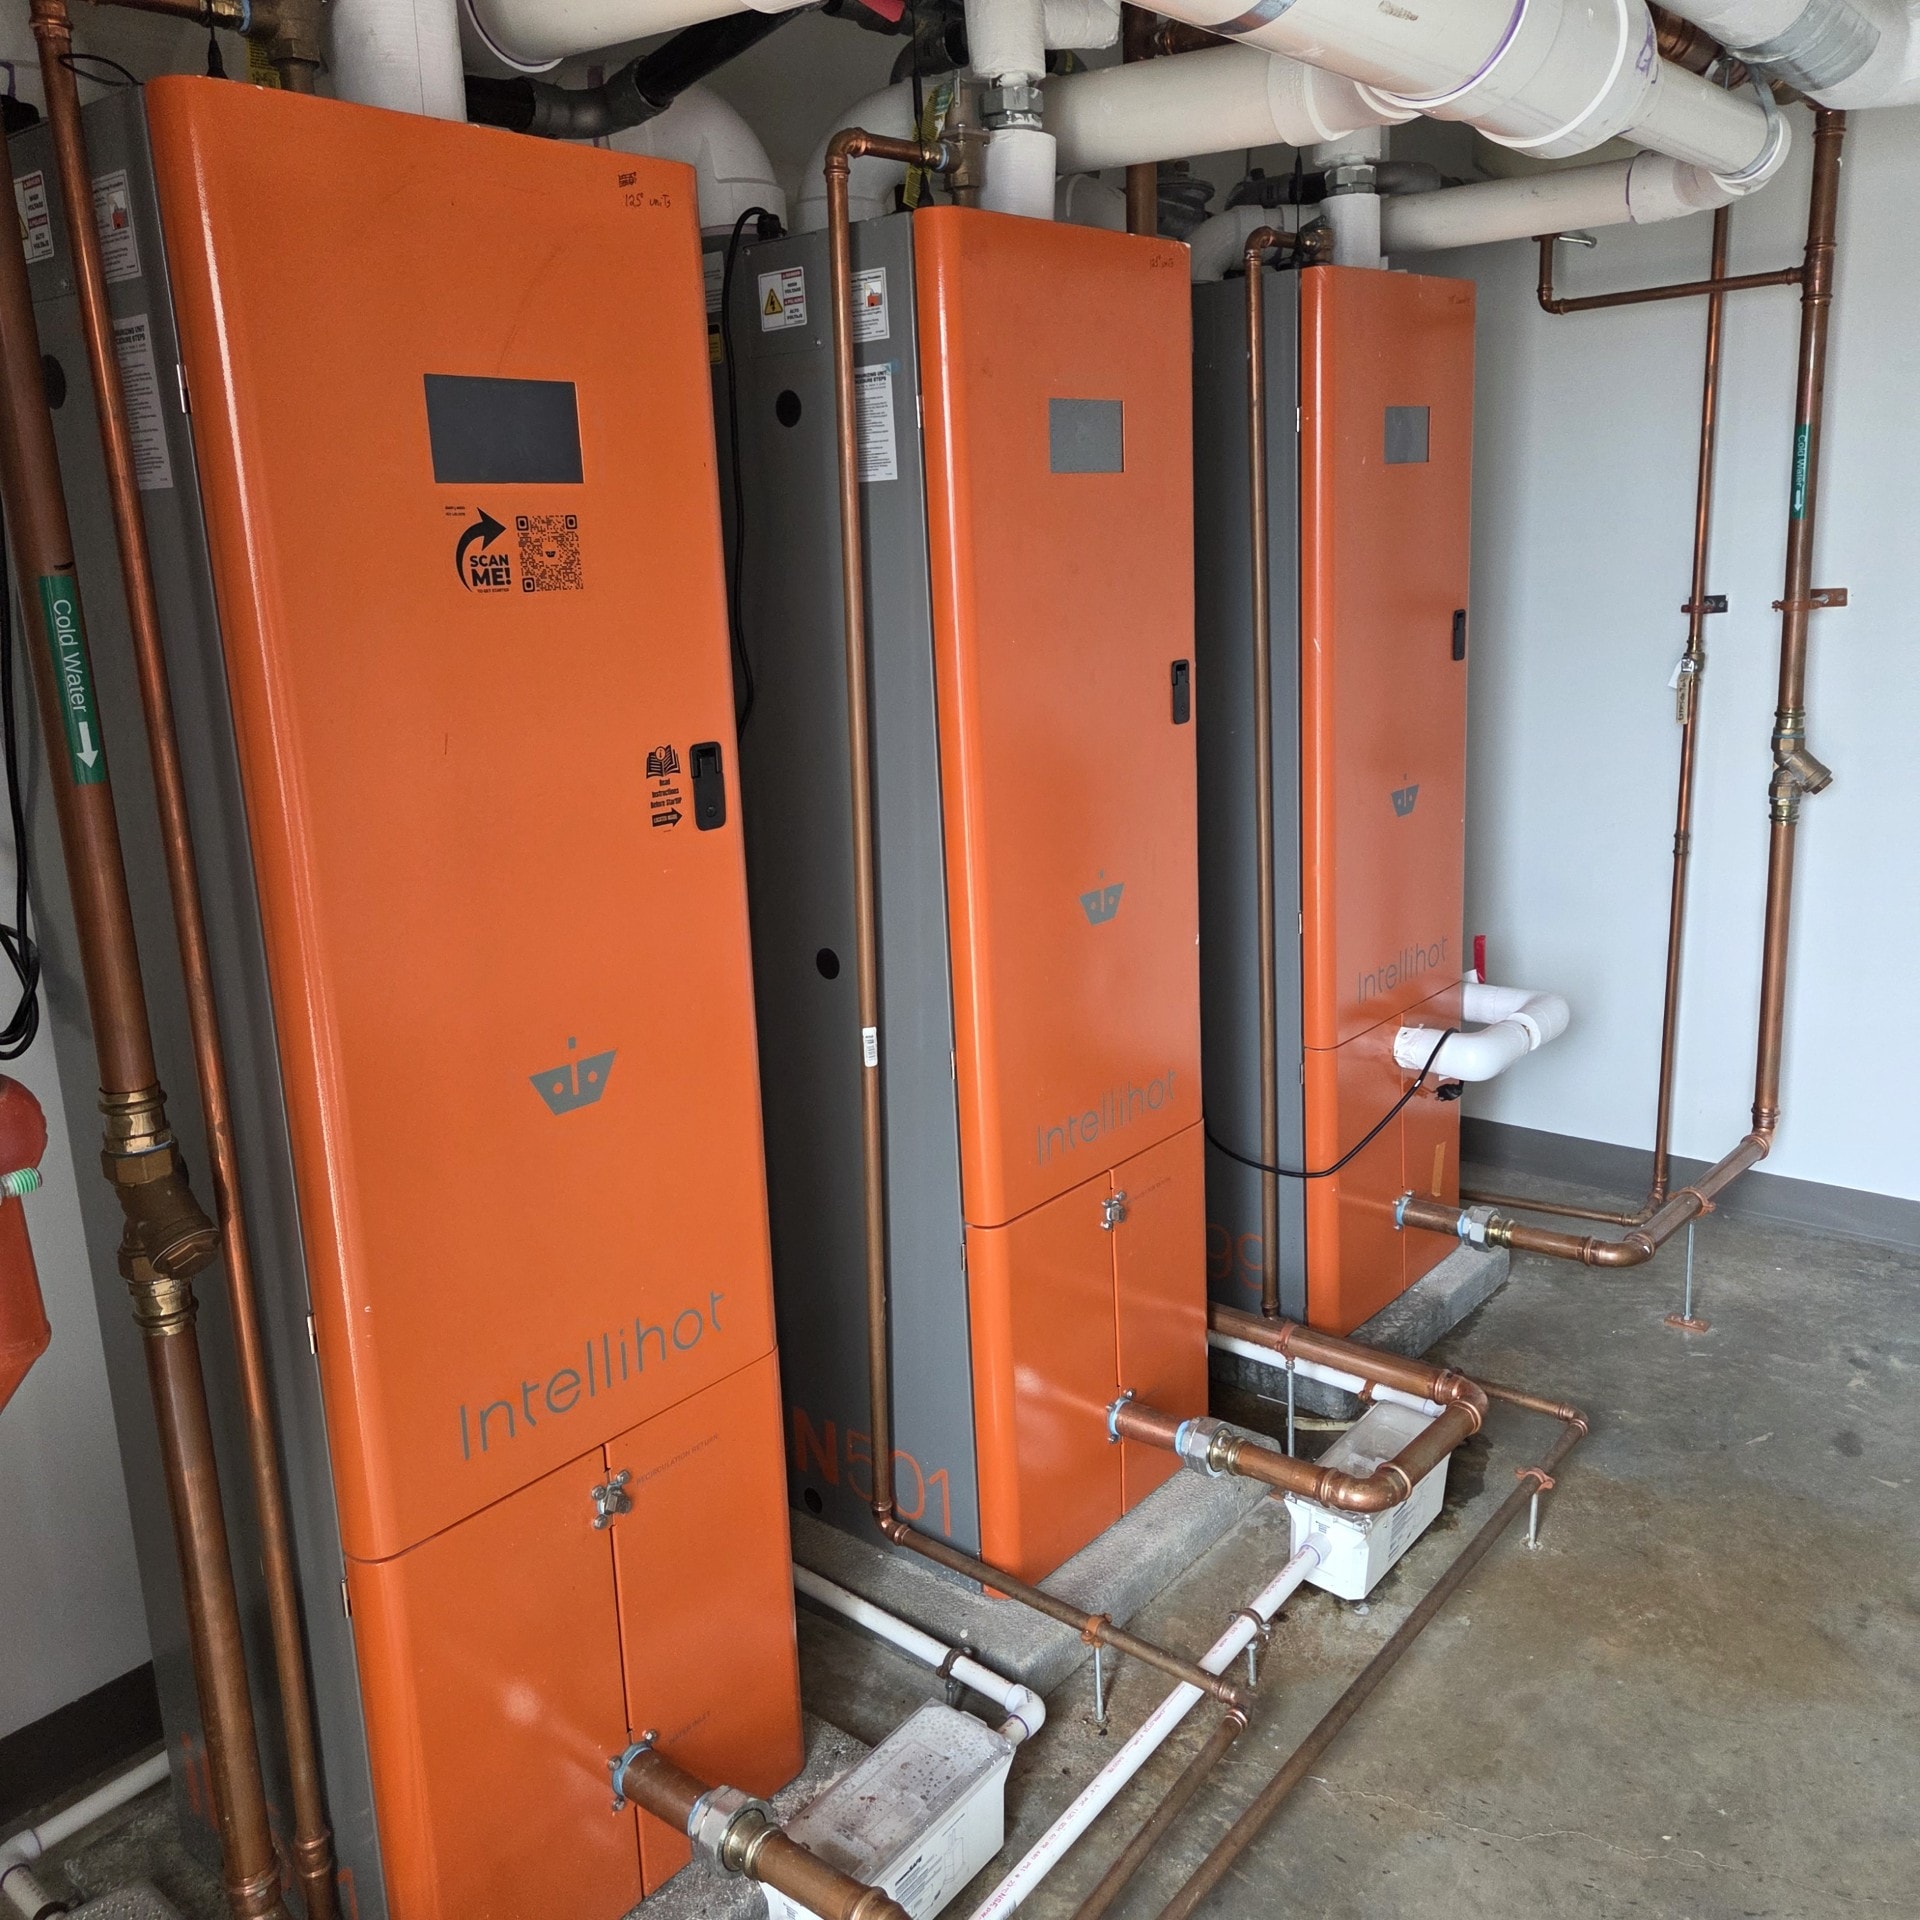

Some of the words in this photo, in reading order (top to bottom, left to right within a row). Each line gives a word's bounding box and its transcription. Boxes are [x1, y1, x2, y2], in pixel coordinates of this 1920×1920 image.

[1797, 434, 1806, 456] Cold
[1795, 458, 1805, 487] Water
[469, 554, 509, 568] SCAN
[470, 567, 512, 587] ME!
[53, 599, 79, 647] Cold
[63, 652, 88, 713] Water
[1358, 935, 1448, 1004] Intellihot
[1037, 1068, 1177, 1166] Intellihot
[459, 1290, 725, 1461] Intellihot
[636, 1449, 691, 1486] RECIRCULATION
